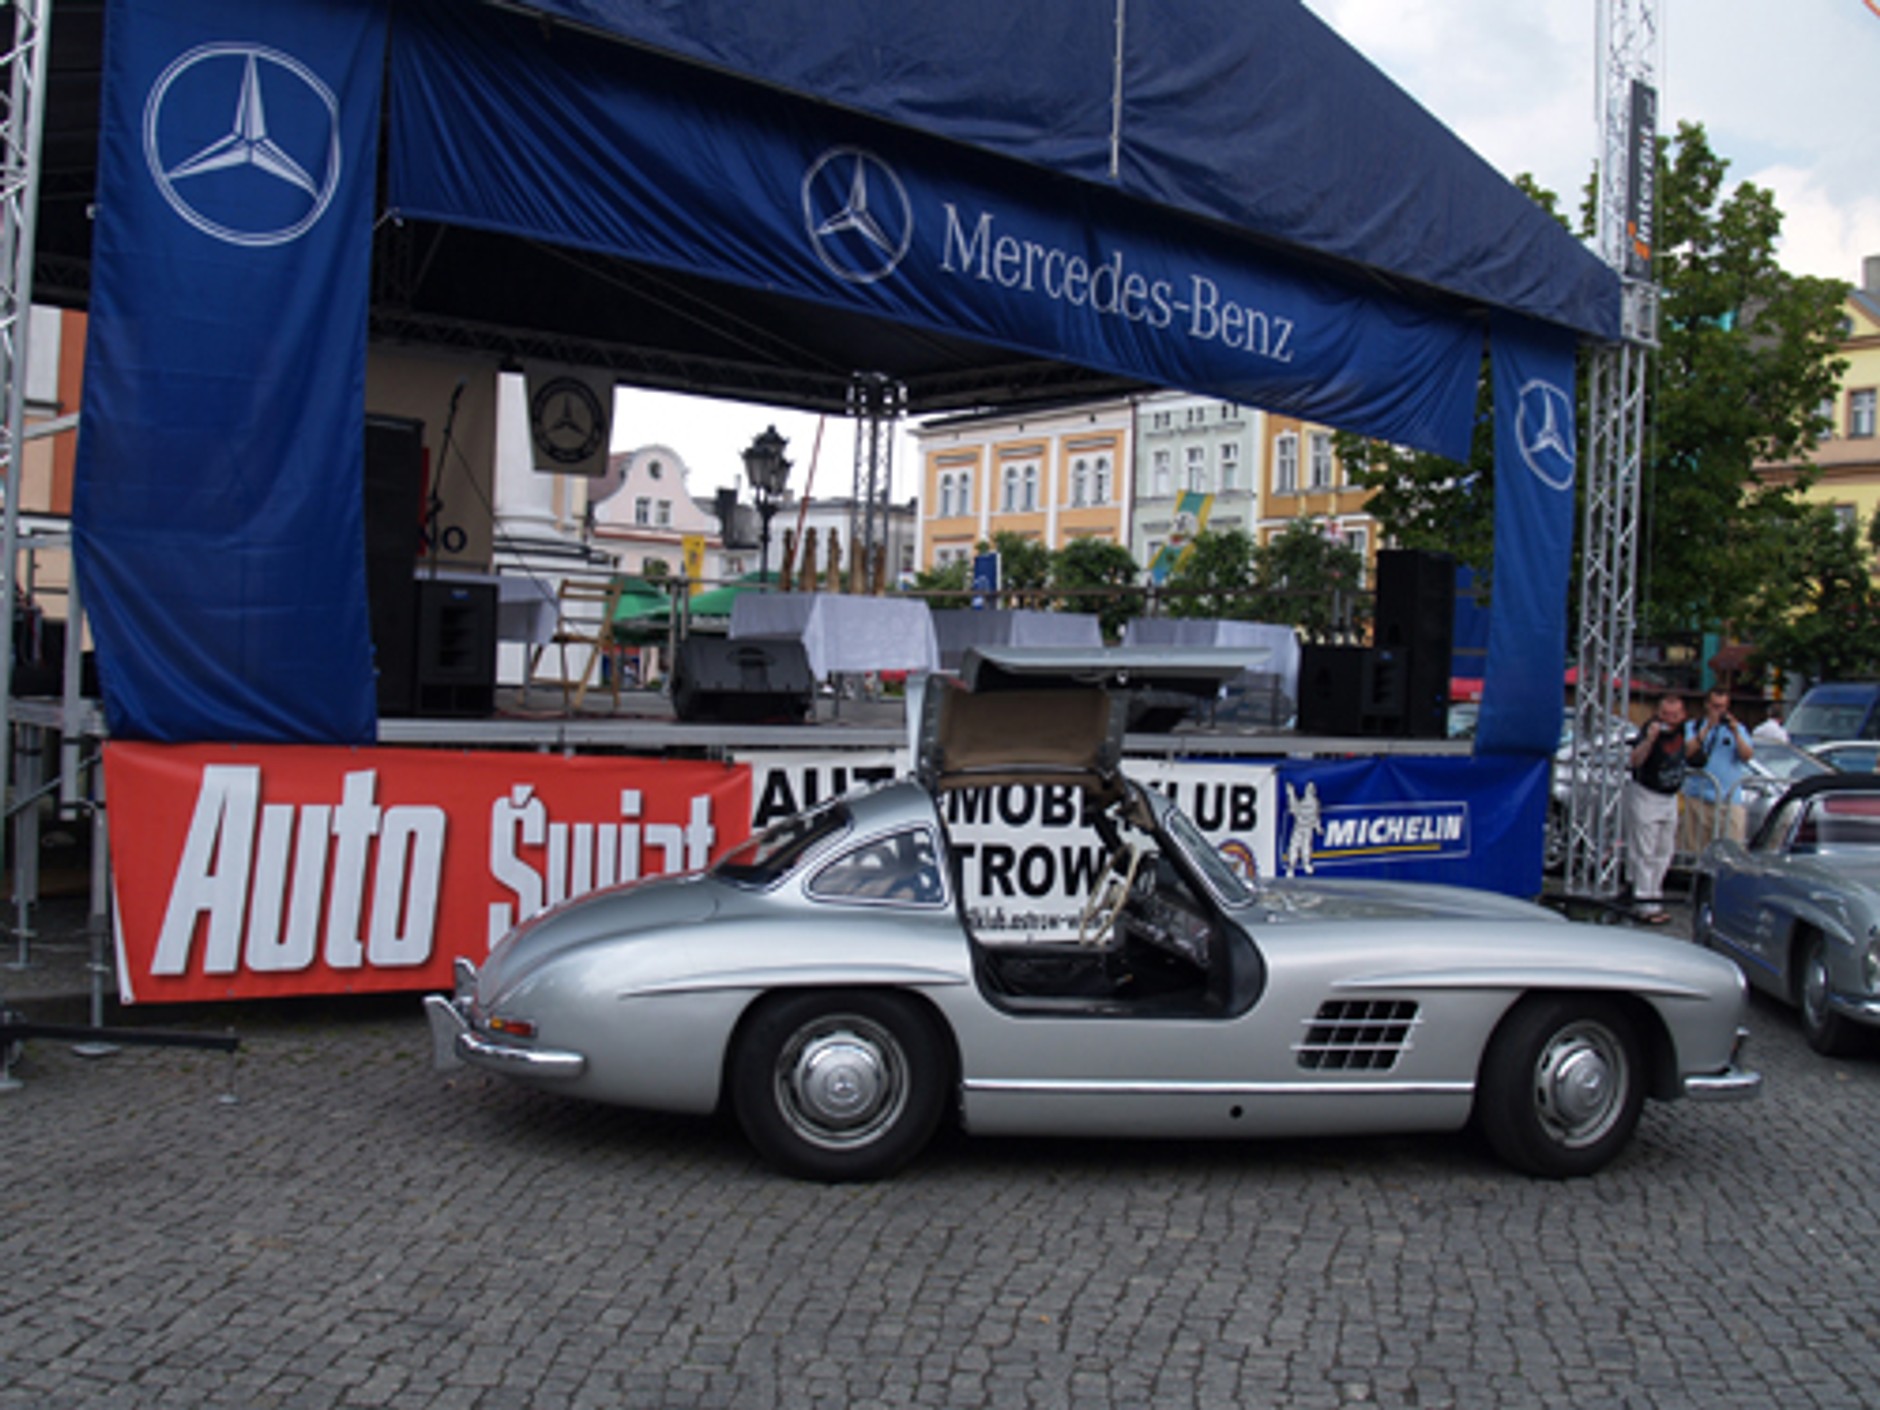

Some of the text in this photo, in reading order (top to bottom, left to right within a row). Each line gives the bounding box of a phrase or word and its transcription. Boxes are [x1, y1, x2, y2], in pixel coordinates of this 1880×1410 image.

[940, 202, 1295, 363] Mercedes-Benz
[150, 763, 447, 975] Auto
[1323, 814, 1463, 848] MICHELIN
